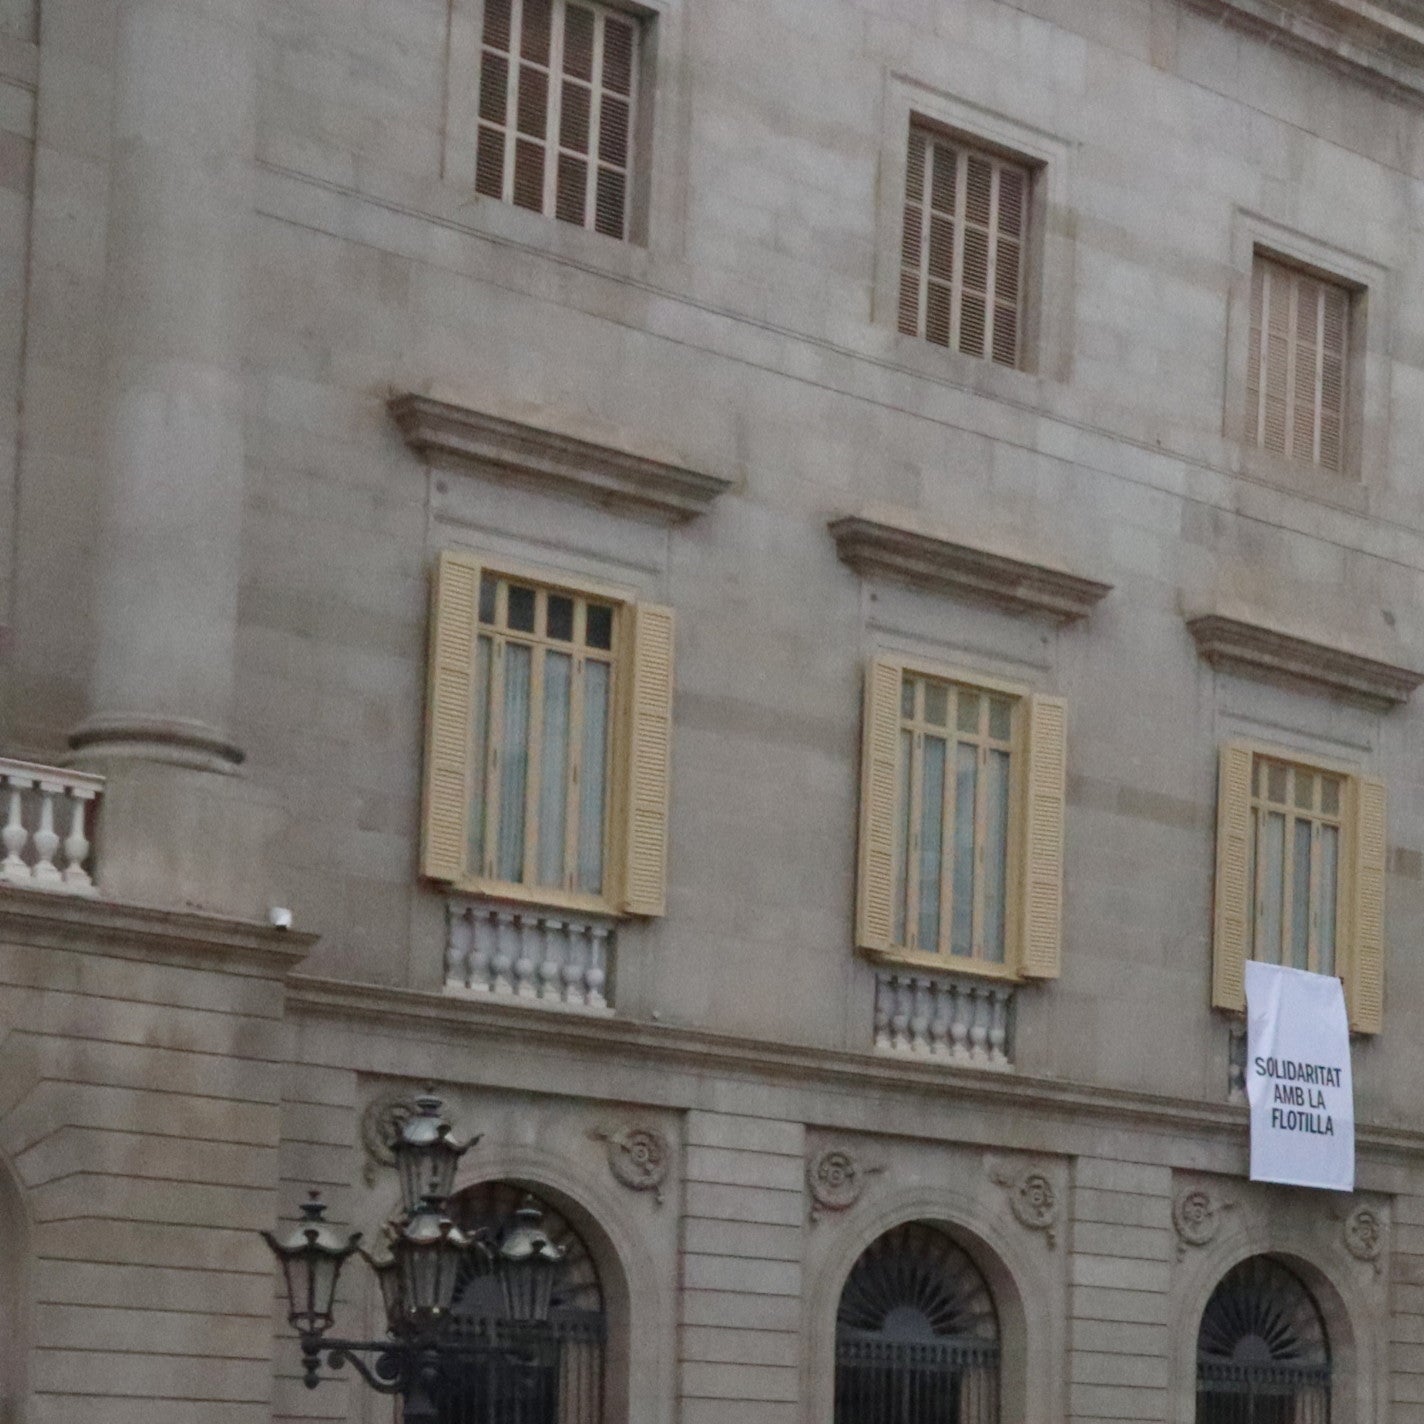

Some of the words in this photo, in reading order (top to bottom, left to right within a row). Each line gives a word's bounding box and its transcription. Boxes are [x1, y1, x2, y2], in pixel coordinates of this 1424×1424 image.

[1255, 1057, 1342, 1088] SOLIDARITAT
[1274, 1084, 1305, 1107] AMB
[1308, 1089, 1326, 1110] LA
[1272, 1108, 1334, 1136] FLOTILLA
